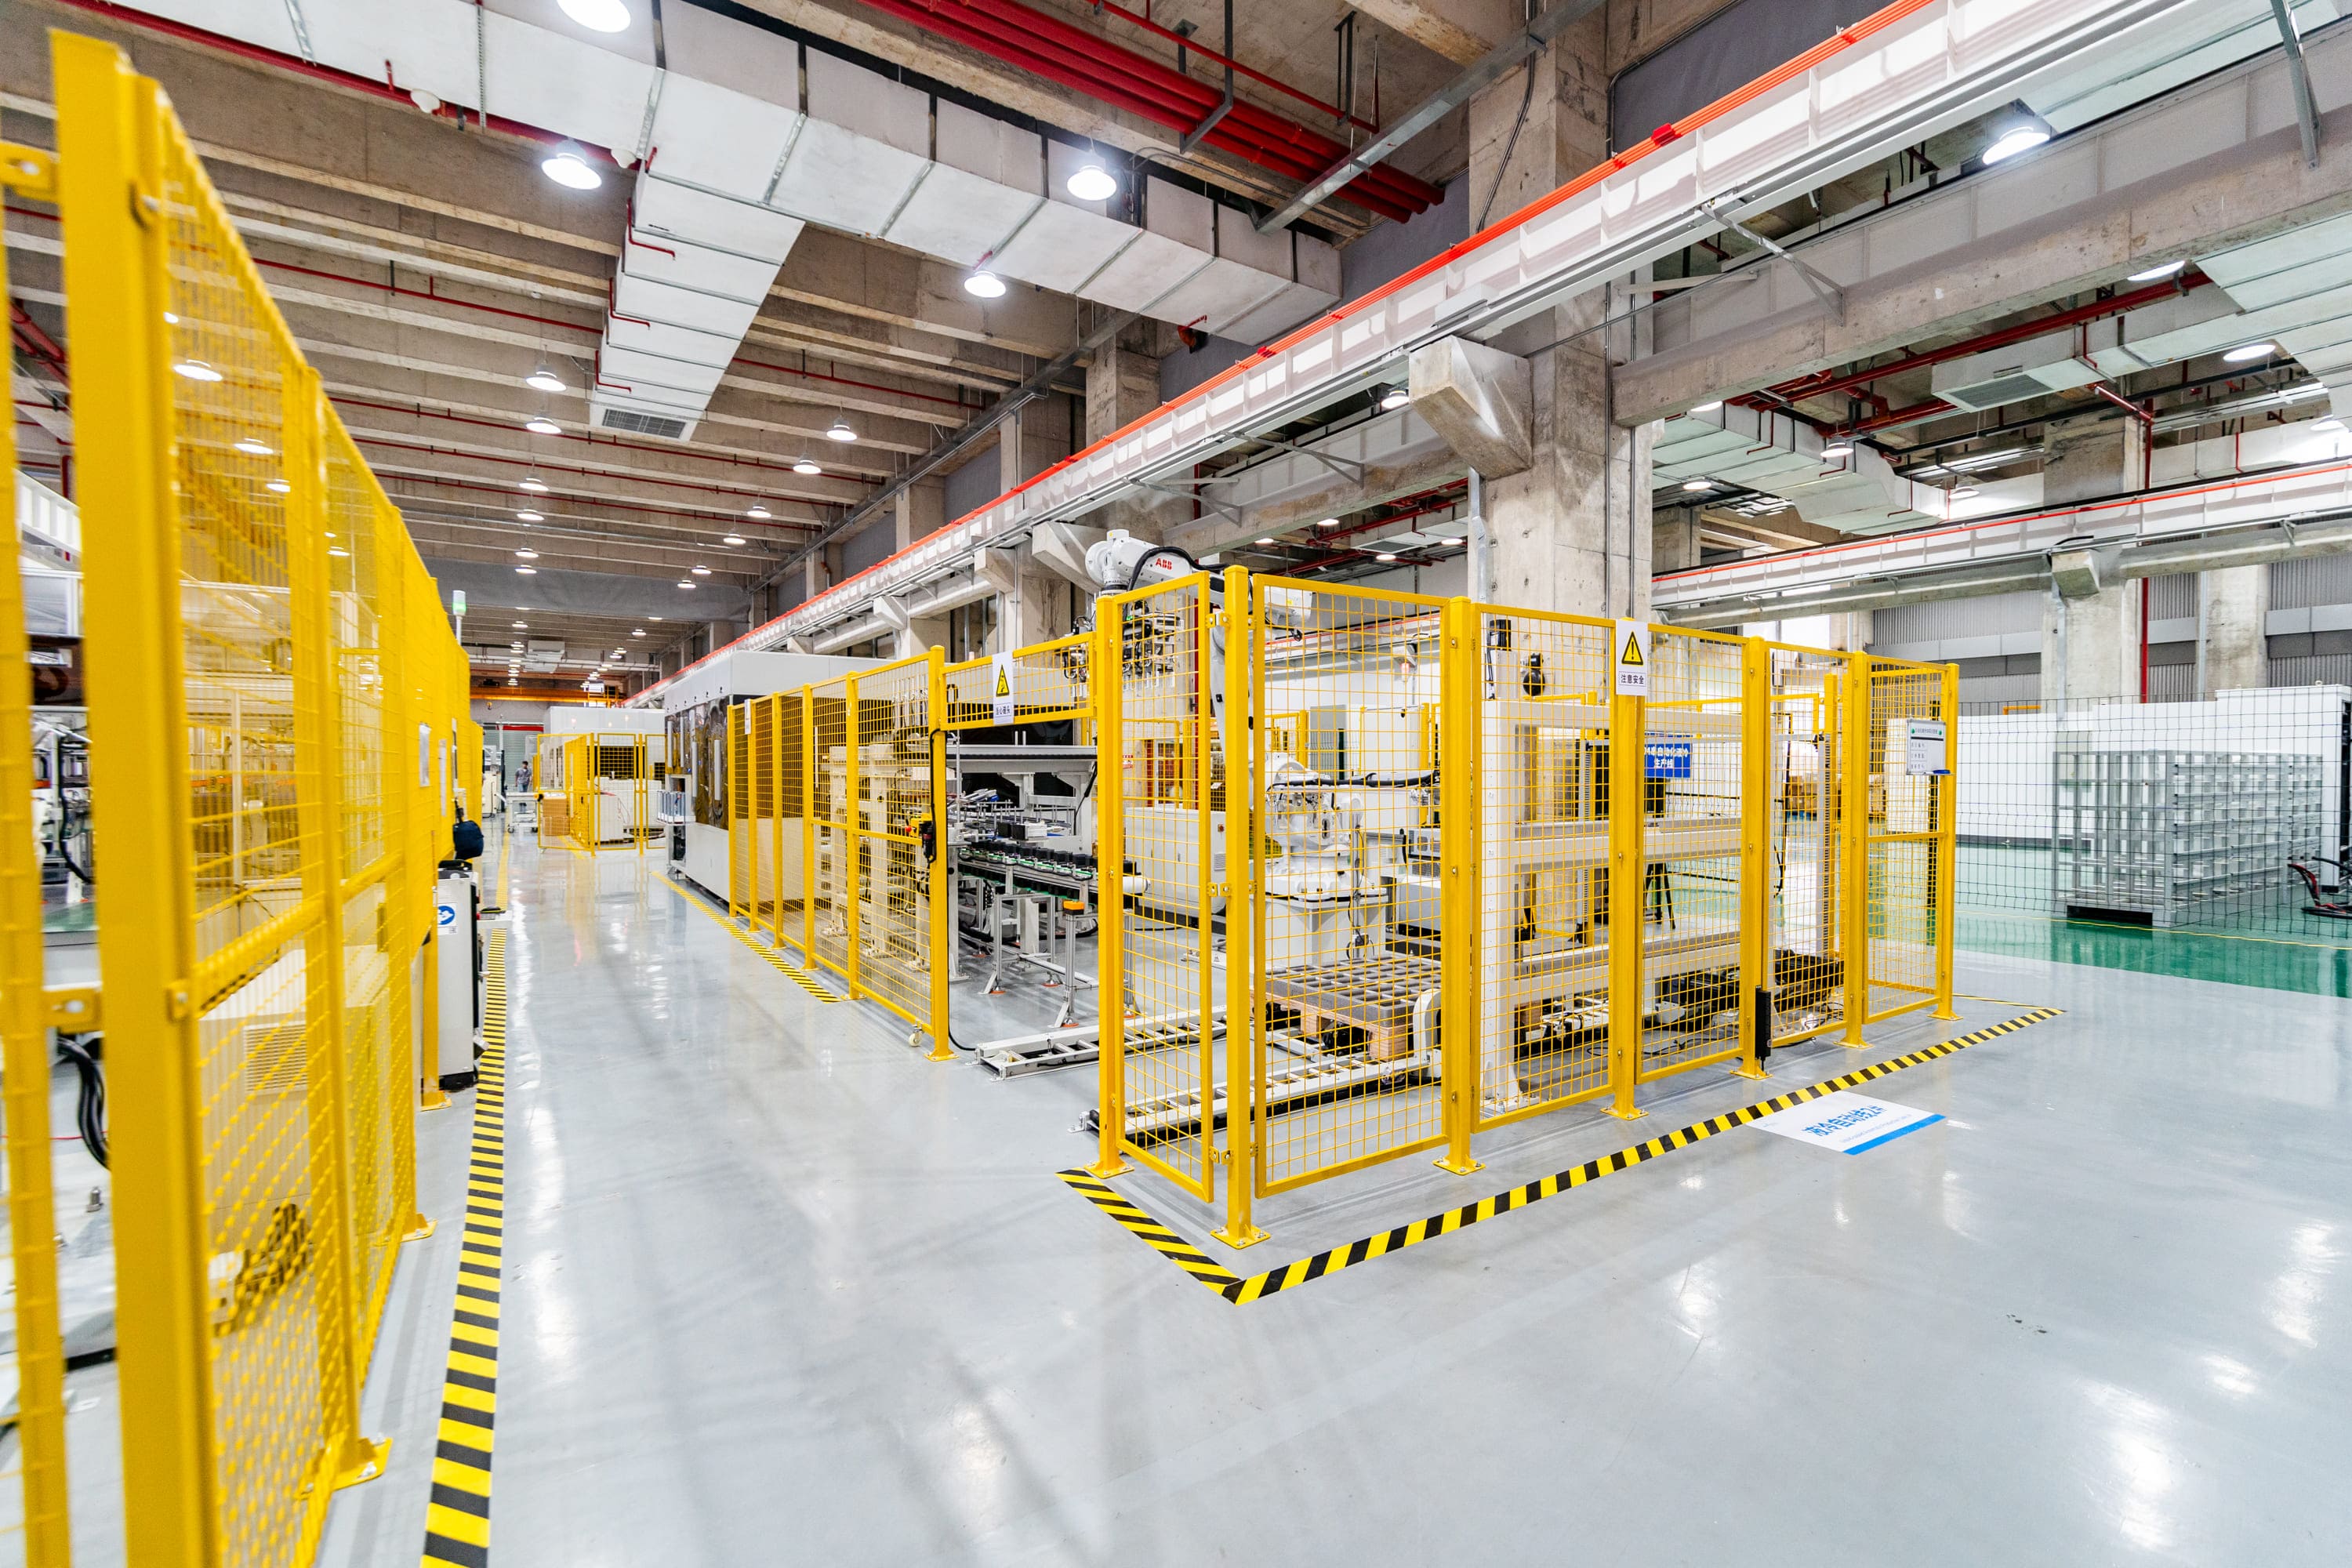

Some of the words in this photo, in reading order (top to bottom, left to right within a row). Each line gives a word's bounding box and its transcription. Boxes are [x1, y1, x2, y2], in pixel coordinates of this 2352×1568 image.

[1156, 558, 1172, 570] ABB
[1621, 674, 1644, 684] 注意安全
[1802, 1105, 1888, 1137] 液冷自动线2#
